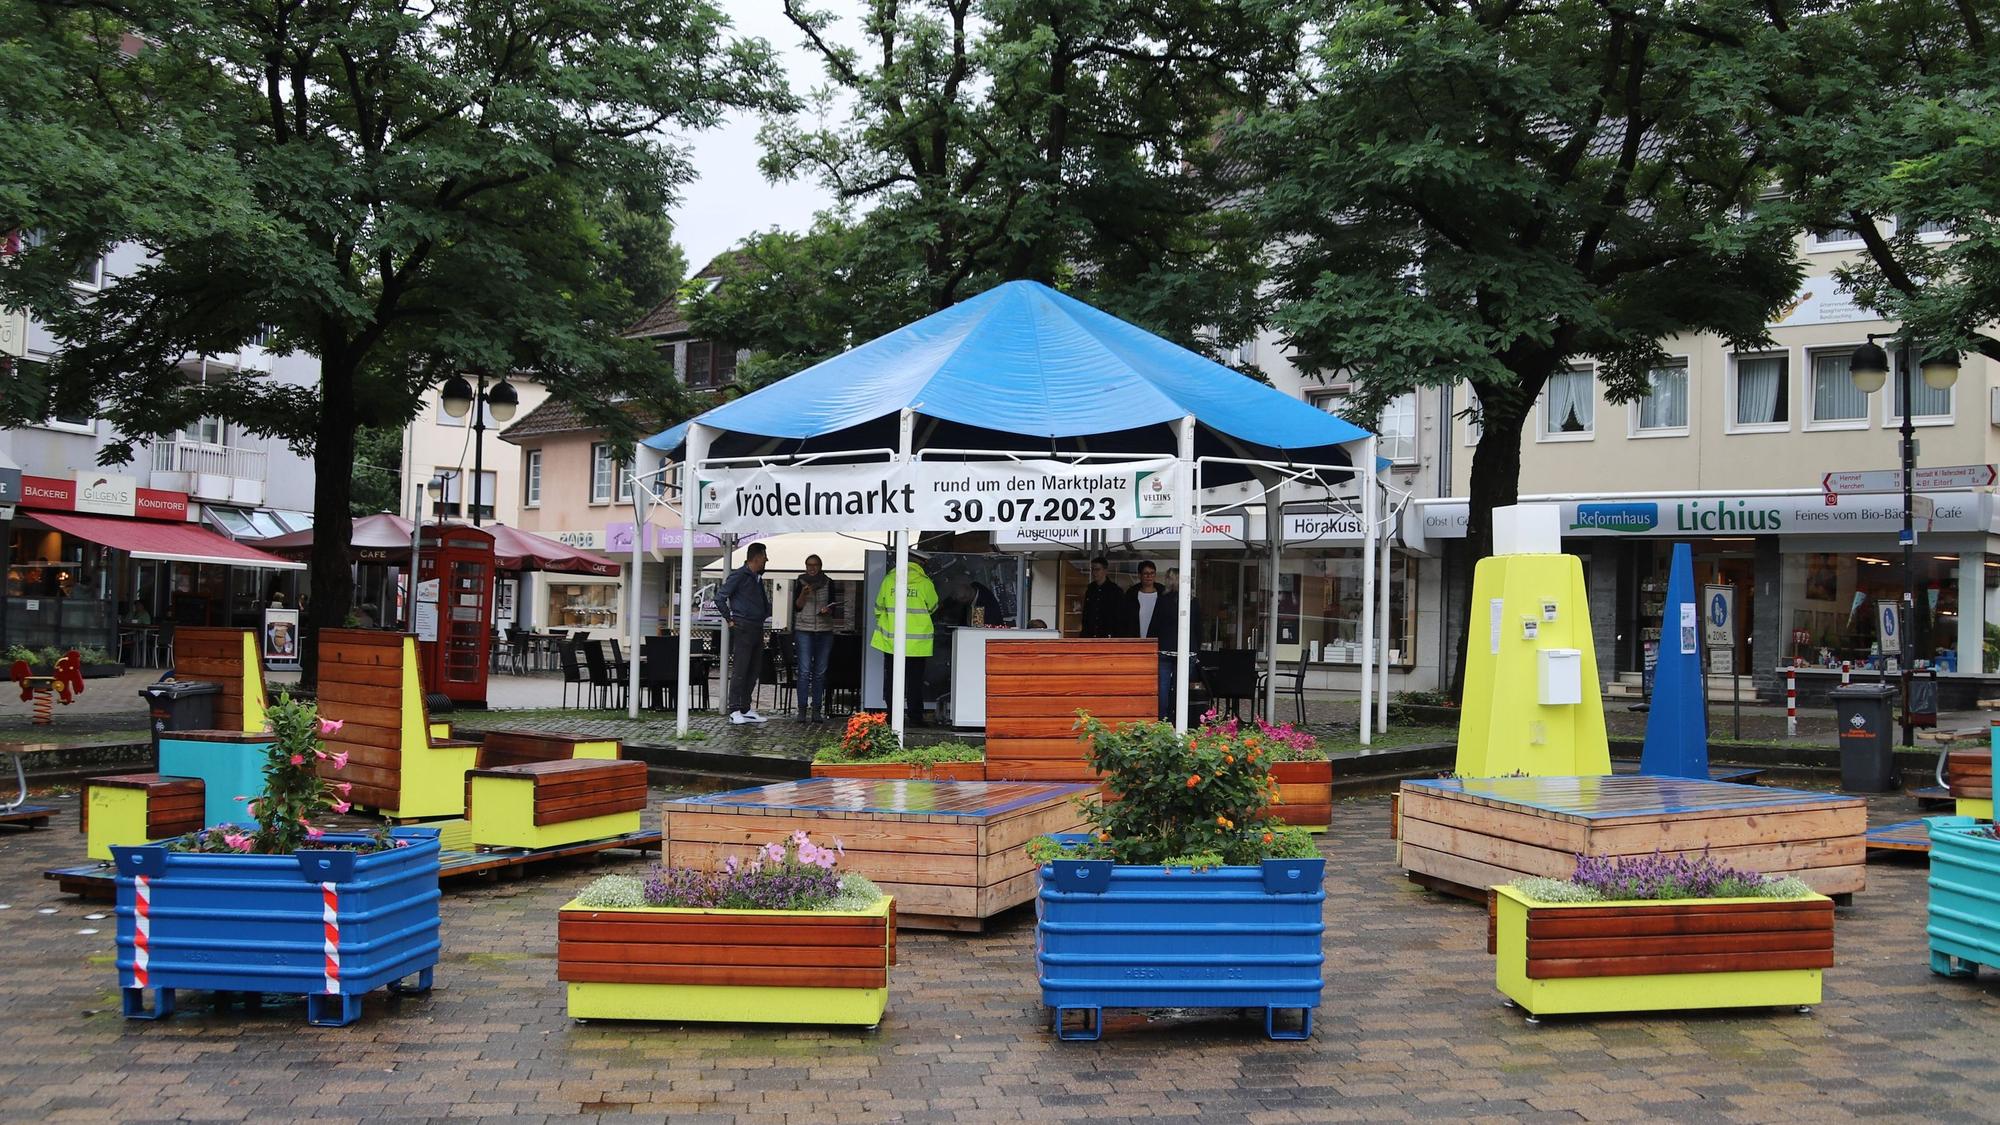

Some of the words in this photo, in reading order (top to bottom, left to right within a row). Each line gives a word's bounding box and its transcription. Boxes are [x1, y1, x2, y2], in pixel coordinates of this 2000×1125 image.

[933, 477, 970, 492] rund
[976, 479, 1000, 491] um
[1006, 476, 1035, 491] den
[1042, 475, 1127, 494] Marktplatz
[138, 497, 185, 511] KONDITOREI
[1143, 494, 1171, 502] VELTINS
[943, 497, 1116, 523] 30.07.2023
[1579, 511, 1650, 528] Reformhaus
[1677, 500, 1782, 531] Lichius
[1795, 510, 1829, 521] Feines
[1833, 512, 1857, 520] vom
[1861, 509, 1905, 520] Bio-Bäc
[1935, 506, 1962, 519] Café
[1294, 518, 1362, 534] Hörakust
[1426, 516, 1447, 527] Obst
[890, 588, 918, 598] PZEI
[1712, 631, 1727, 640] ZONE
